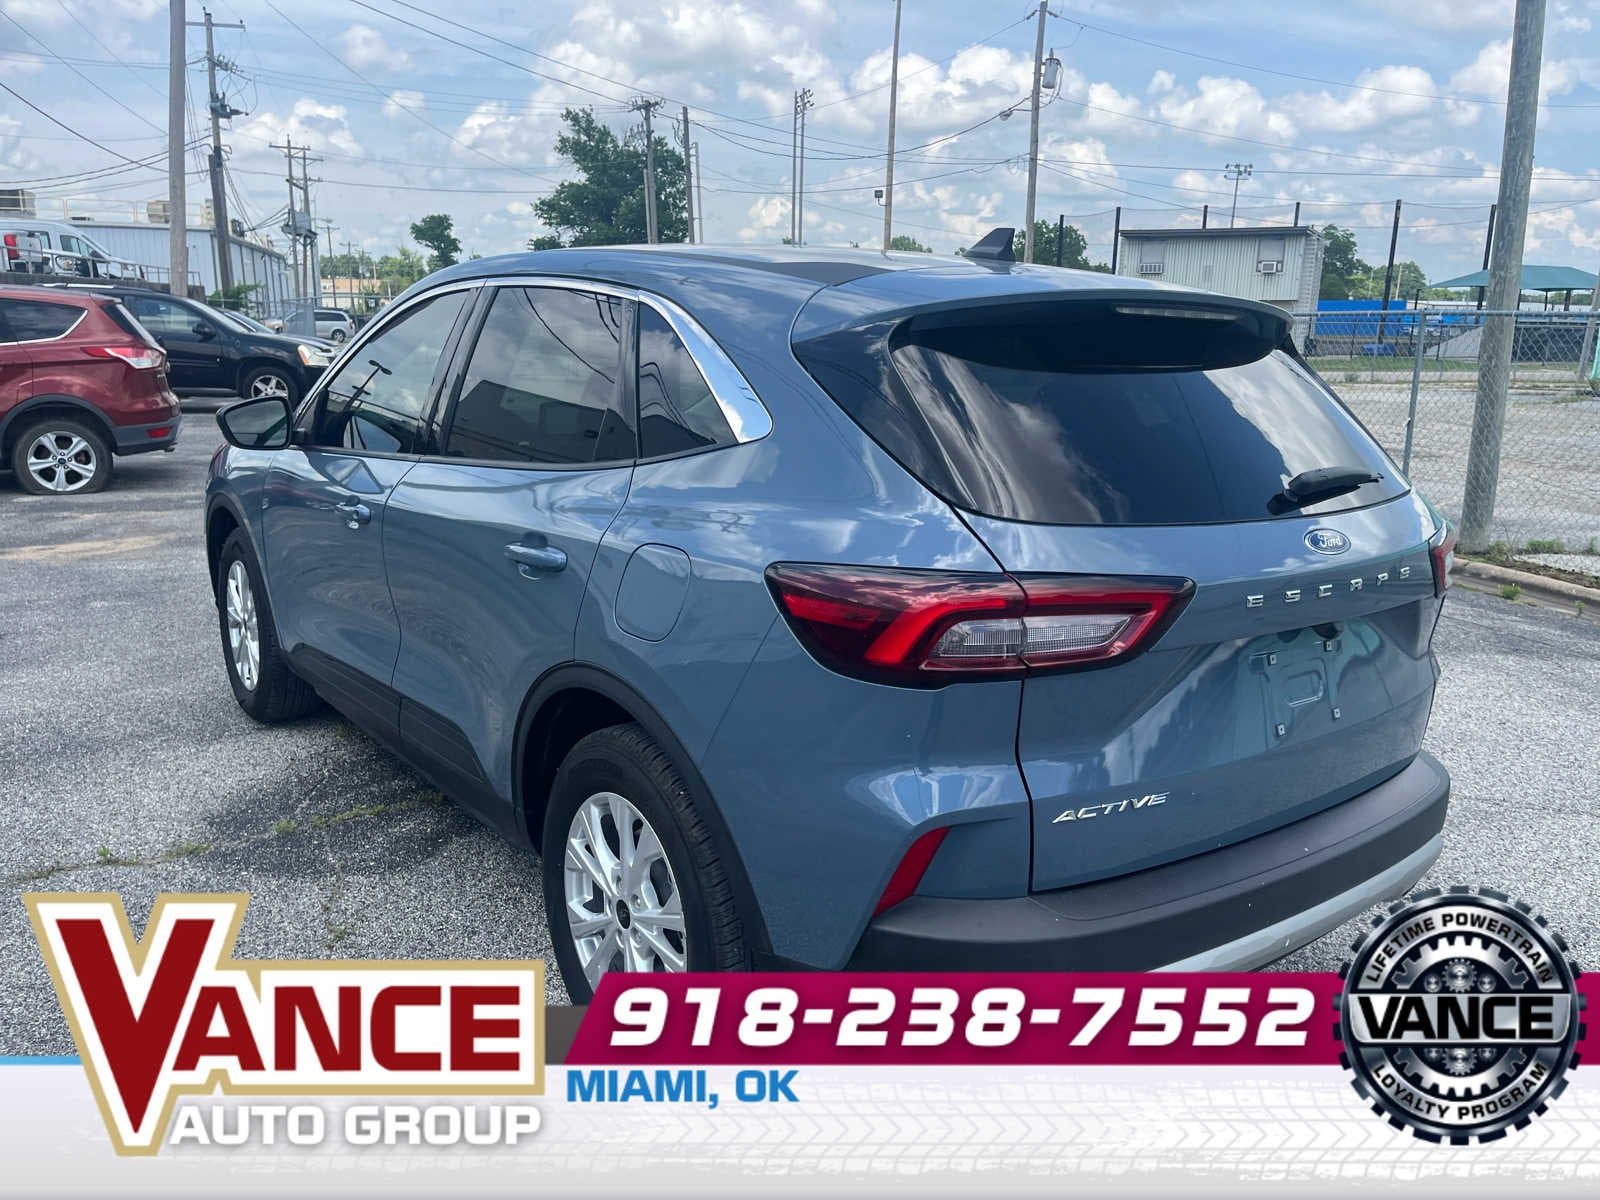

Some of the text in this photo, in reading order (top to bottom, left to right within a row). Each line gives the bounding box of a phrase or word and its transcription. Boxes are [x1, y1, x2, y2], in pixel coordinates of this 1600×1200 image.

[1316, 532, 1346, 548] Ford
[1247, 566, 1411, 608] ESCAPE
[1051, 791, 1171, 824] ACTIVE
